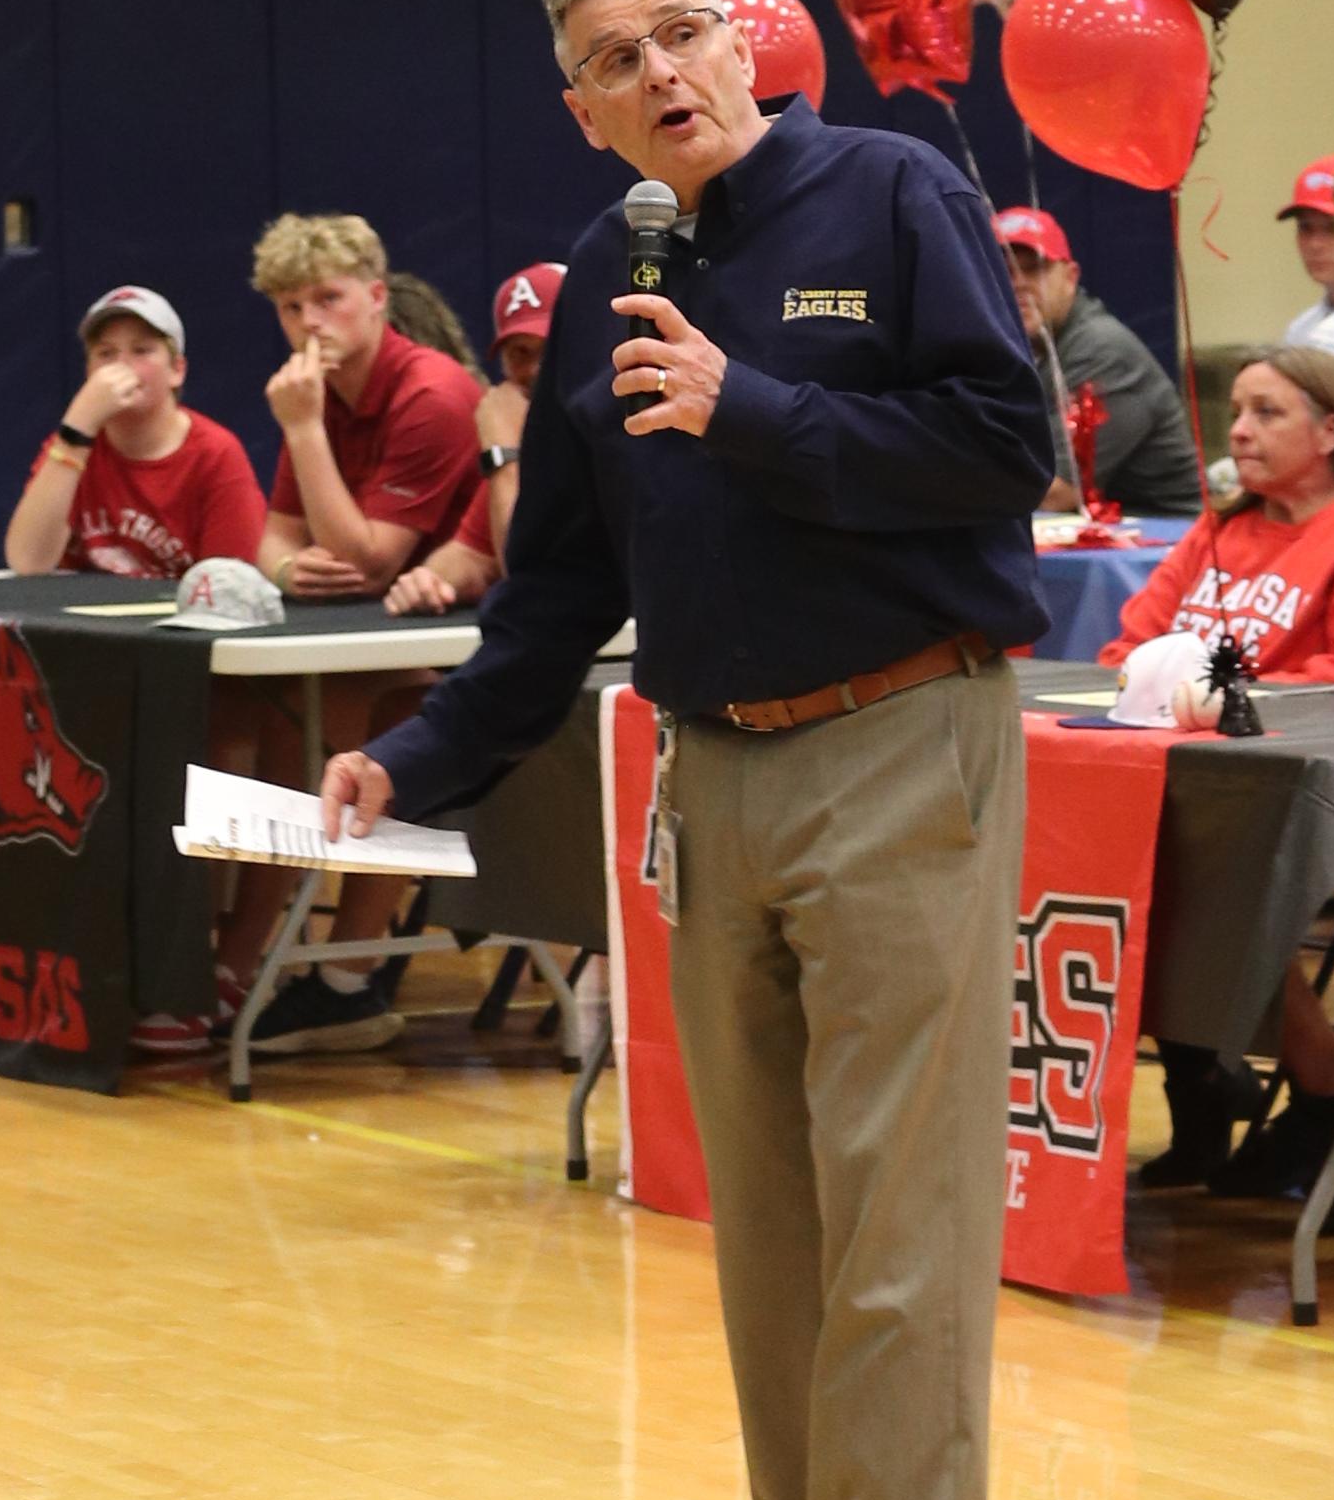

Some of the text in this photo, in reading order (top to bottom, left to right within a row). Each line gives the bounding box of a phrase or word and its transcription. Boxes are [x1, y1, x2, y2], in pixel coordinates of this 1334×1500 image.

[505, 276, 541, 314] A
[782, 299, 867, 322] EAGLES
[188, 573, 214, 607] A
